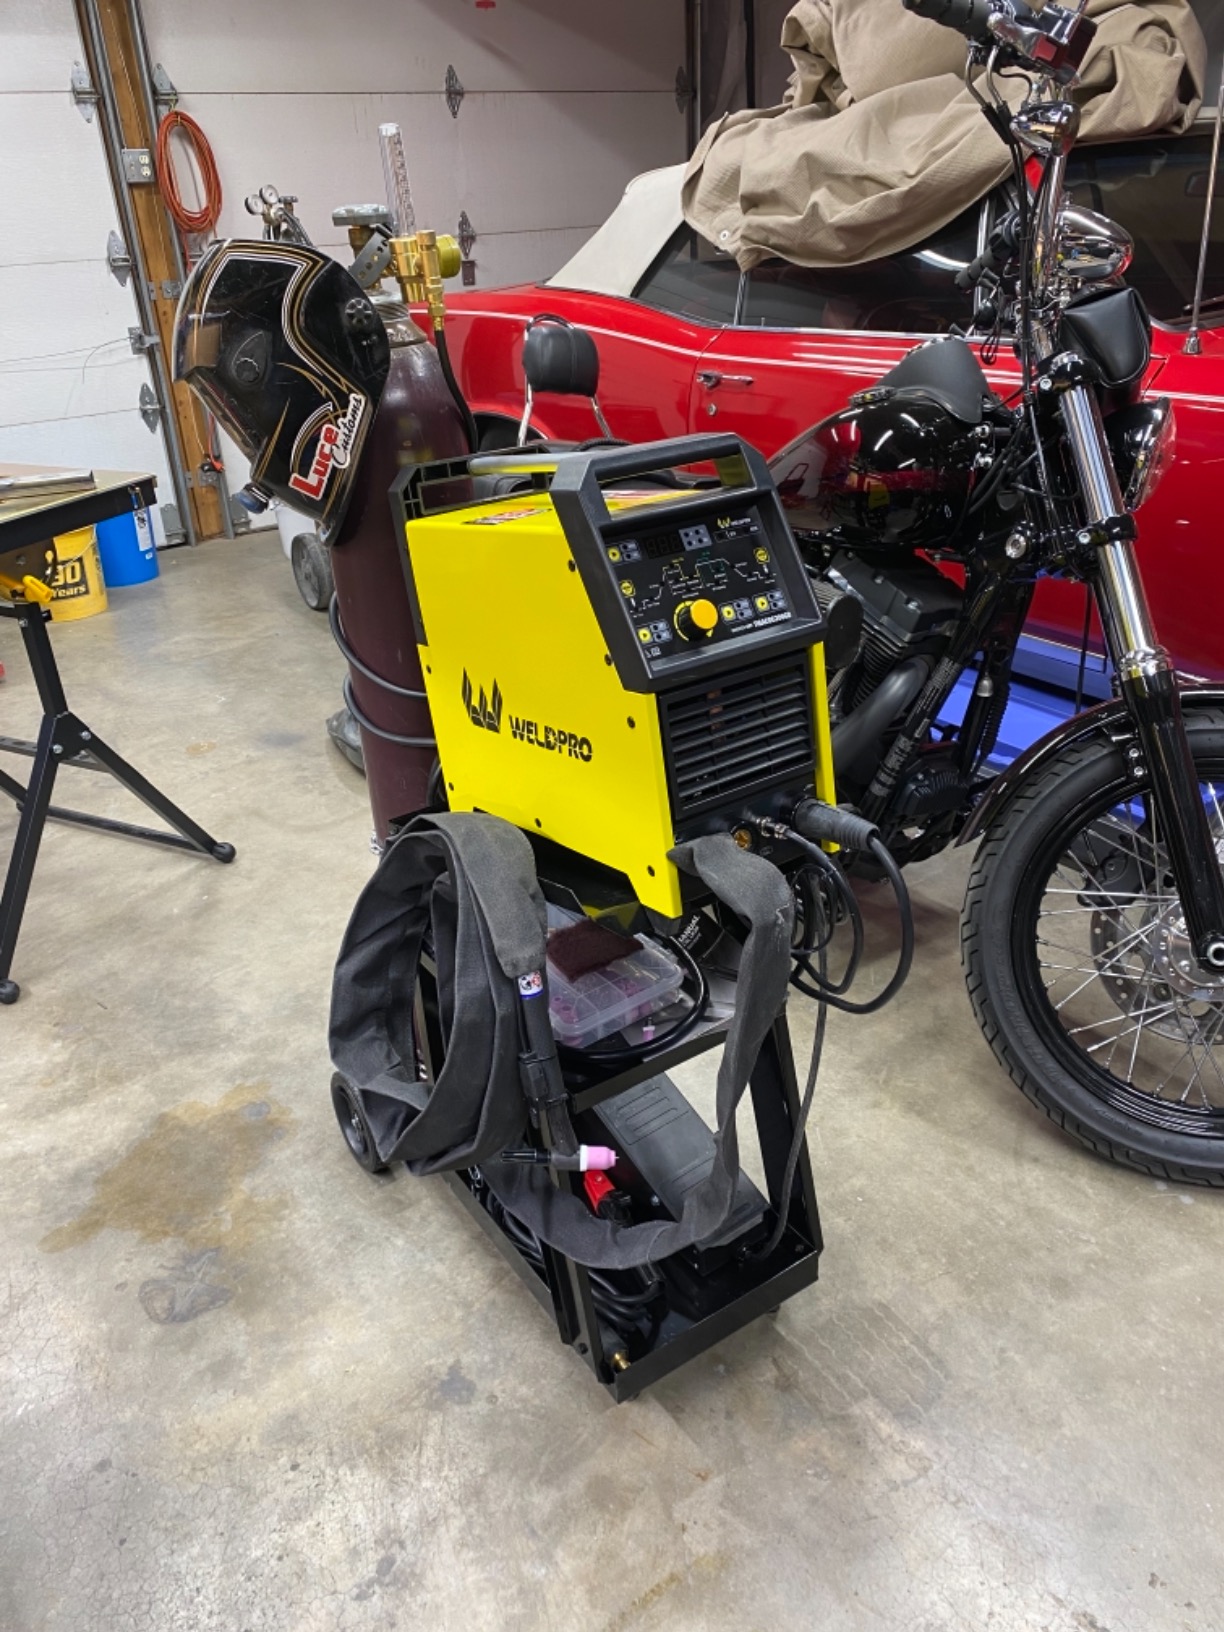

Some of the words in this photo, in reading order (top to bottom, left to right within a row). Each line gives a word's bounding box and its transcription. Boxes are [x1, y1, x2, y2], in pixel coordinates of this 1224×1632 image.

[290, 426, 340, 499] Luce
[331, 396, 362, 466] Customs
[508, 714, 593, 762] WELDPRO
